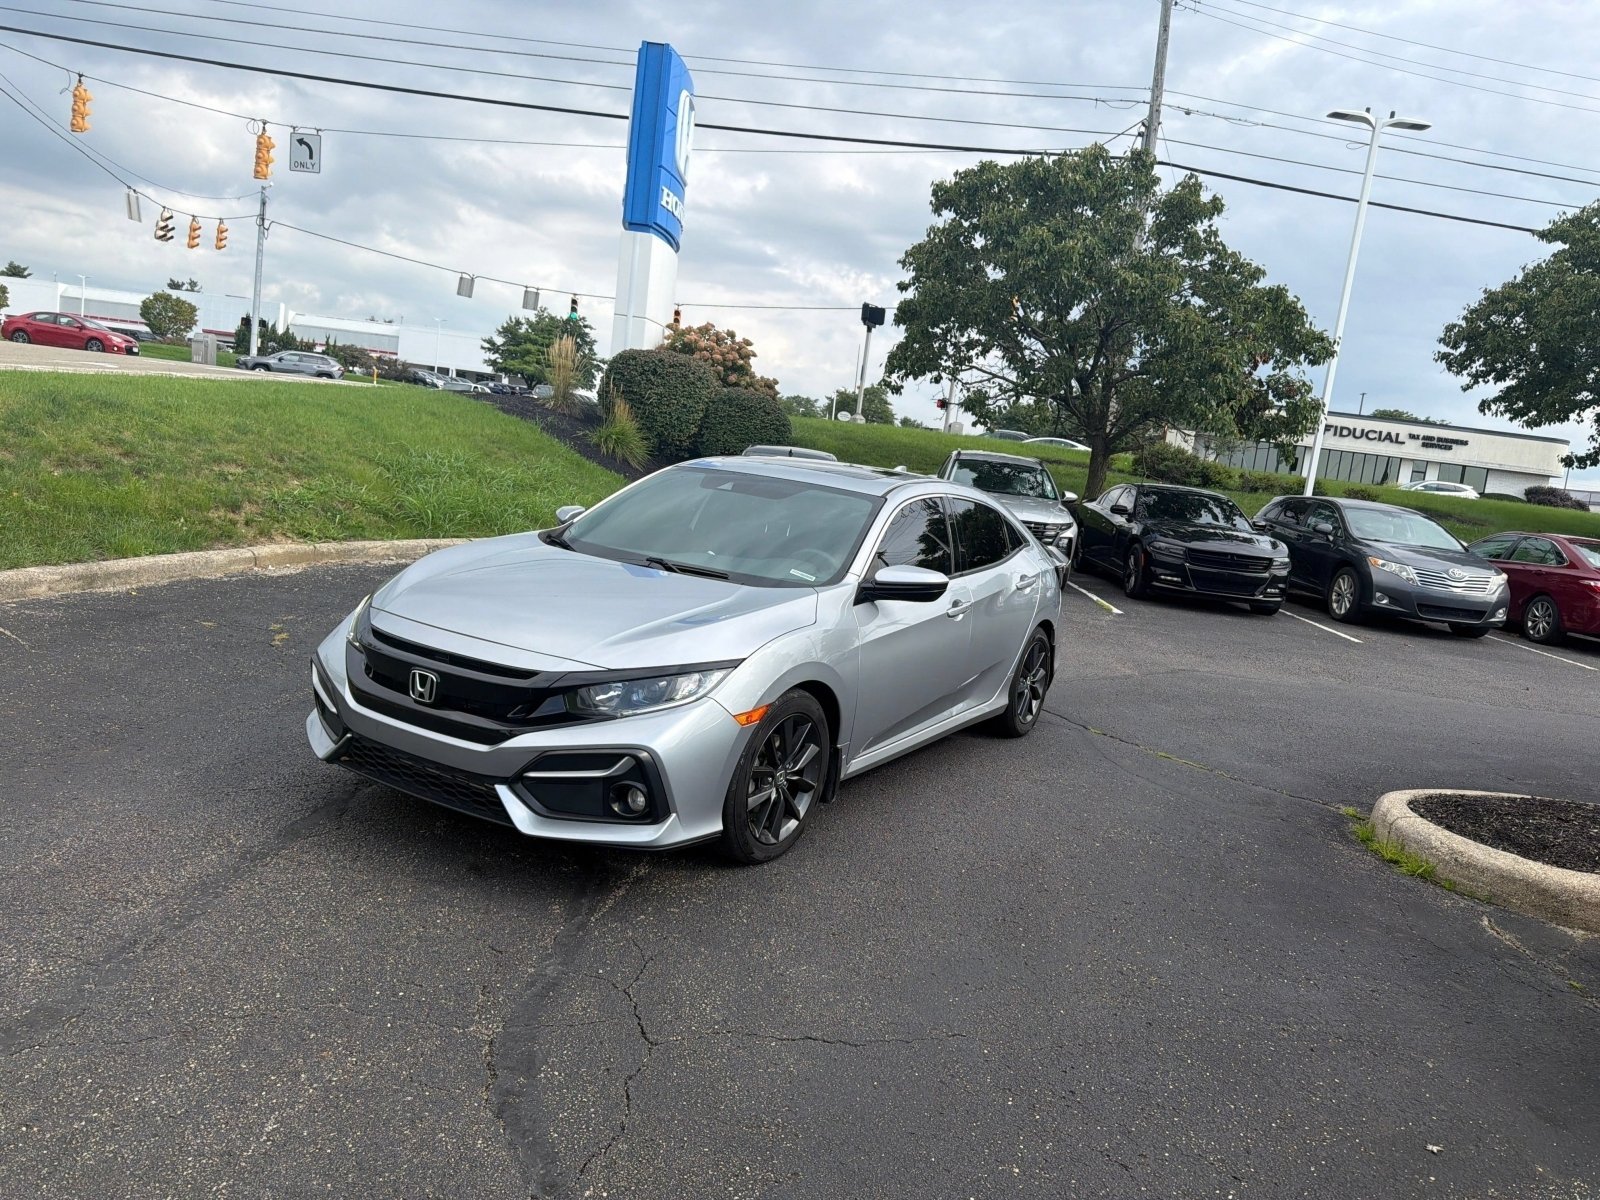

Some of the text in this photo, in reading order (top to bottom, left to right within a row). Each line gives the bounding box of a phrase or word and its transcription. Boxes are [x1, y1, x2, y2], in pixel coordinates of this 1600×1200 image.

[293, 160, 316, 170] ONLY
[1323, 424, 1405, 445] FIDUCIAL
[1408, 433, 1420, 441] TAX
[1436, 436, 1469, 446] BUSINESS
[1421, 441, 1453, 451] SERVICES
